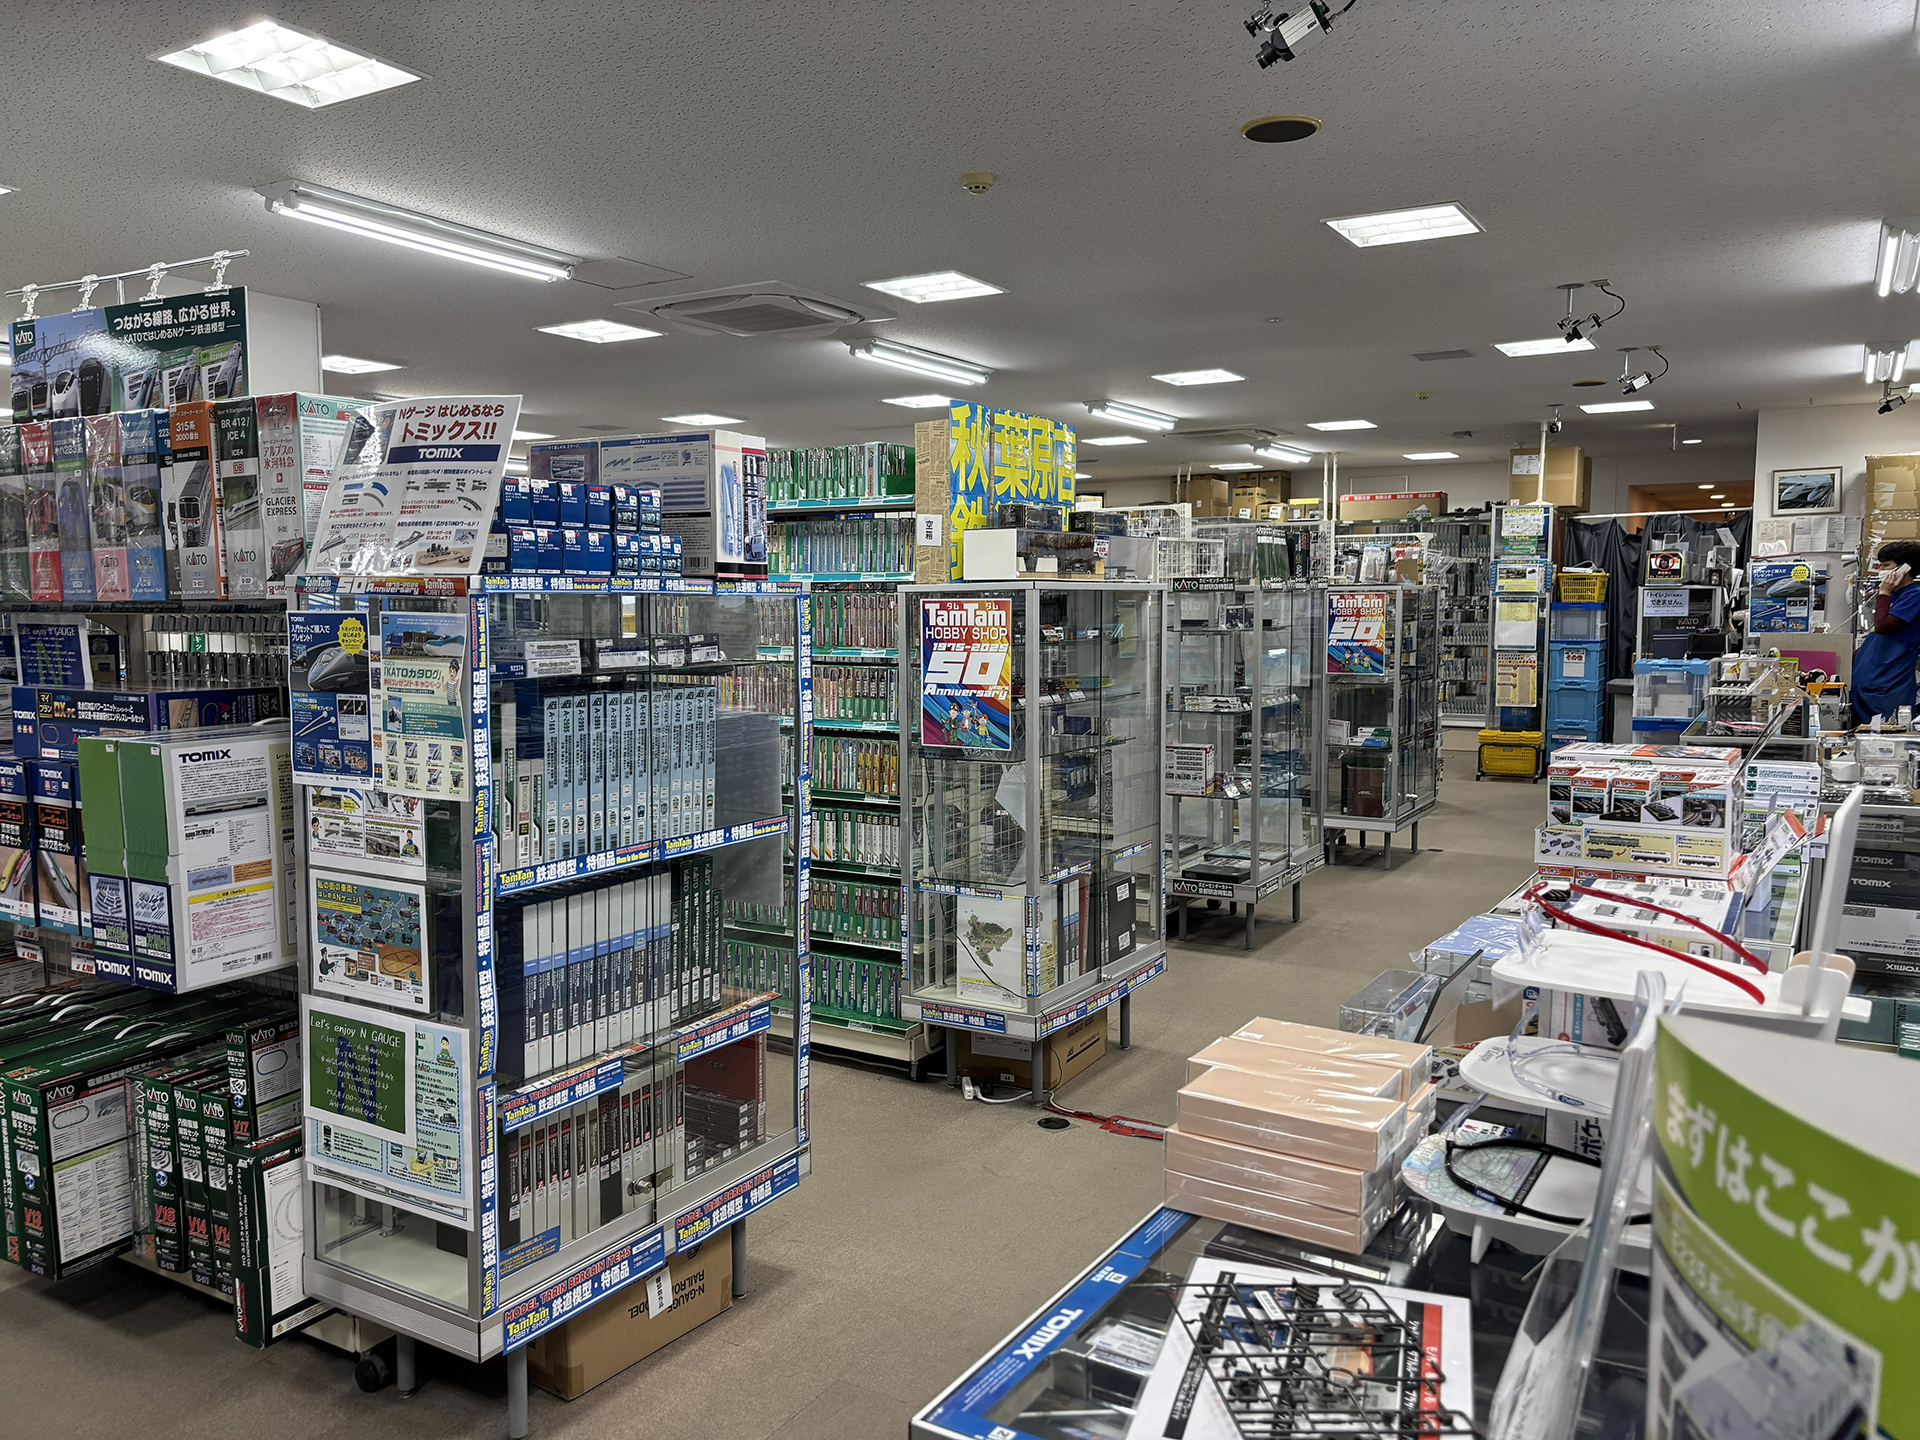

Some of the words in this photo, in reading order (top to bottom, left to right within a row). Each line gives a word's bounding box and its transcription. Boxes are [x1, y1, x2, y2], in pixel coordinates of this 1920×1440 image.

[114, 301, 236, 330] つながる線路、広がる世界。
[15, 330, 34, 345] KATO
[124, 322, 226, 343] KATOではじめるNゲージ鉄道模型
[300, 401, 330, 416] KATO
[399, 405, 435, 420] Nゲージ
[438, 405, 505, 418] はじめるなら
[176, 420, 196, 432] 315系
[221, 419, 231, 428] BR
[227, 432, 239, 441] ICE
[240, 432, 246, 440] 4
[402, 420, 498, 443] トミックス!!
[264, 446, 294, 457] アルプスの
[418, 447, 464, 459] TOMIX
[951, 404, 1077, 504] 秋葉原店
[264, 458, 295, 469] 氷河特急
[266, 496, 296, 507] GLACIER
[267, 506, 297, 516] EXPRESS
[925, 520, 934, 540] 空箱
[101, 556, 119, 568] KATO
[186, 552, 207, 566] KATO
[234, 548, 257, 563] KATO
[305, 578, 331, 589] TamTam
[423, 578, 454, 591] TamTam
[511, 577, 573, 590] 鉄道模型・特価品
[633, 580, 685, 591] 鉄道模型・特価品
[737, 583, 777, 593] 鉄道模型・特価品
[1175, 579, 1199, 590] KATO
[1330, 595, 1383, 608] TamTam
[925, 603, 1007, 627] TamTam
[1330, 608, 1358, 616] HOBBY
[1360, 608, 1384, 616] SHOP
[54, 627, 77, 636] GAUGE
[291, 625, 330, 634] 入門セットご購入で
[926, 628, 967, 640] HOBBY
[972, 627, 1008, 640] SHOP
[1329, 622, 1382, 640] 50
[933, 643, 1010, 652] 1975-2025
[1329, 639, 1384, 648] Anniversary
[384, 667, 442, 681] 「KATOカタログ」
[925, 652, 1008, 685] 50
[801, 635, 812, 723] 鉄道模型・特価品
[41, 694, 50, 703] マイ
[924, 684, 1010, 700] Anniversary
[13, 711, 36, 720] TOMIX
[39, 705, 53, 714] プラン
[473, 670, 489, 787] 鉄道模型・特価品
[179, 750, 232, 764] TOMIX
[0, 766, 18, 776] OMIX
[39, 769, 63, 779] TOMIX
[475, 791, 484, 835] TamTam
[665, 838, 692, 850] TamTam
[694, 823, 754, 850] 鉄道模型・特価品
[801, 815, 812, 900] 鉄道模型・特価品
[1854, 856, 1894, 866] TOMIX
[500, 870, 534, 885] TamTam
[536, 851, 616, 883] 鉄道模型・特価品
[500, 882, 519, 890] HOBBY
[520, 878, 535, 886] SHOP
[936, 884, 976, 896] 鉄道模型・特価品
[1174, 882, 1198, 892] KATO
[1851, 878, 1892, 888] TOMIX
[96, 959, 131, 977] TOMIX
[477, 912, 496, 1028] 鉄道模型・特価品
[137, 967, 173, 985] TOMIX
[944, 1012, 985, 1026] 鉄道模型・特価品
[226, 1032, 244, 1044] KATO
[251, 1028, 276, 1043] KATO
[310, 1016, 330, 1030] Let's
[334, 1025, 356, 1039] enjoy
[360, 1028, 367, 1039] N
[372, 1031, 401, 1048] GAUGE
[704, 1020, 749, 1049] 鉄道模型・特価品
[480, 1031, 491, 1074] TamTam
[800, 1002, 811, 1089] 鉄道模型・特価品
[47, 1085, 75, 1101] KATO
[147, 1087, 169, 1103] KATO
[504, 1096, 528, 1112] MODEL
[530, 1088, 550, 1102] TRAIN
[551, 1078, 578, 1094] BARGAIN
[580, 1067, 597, 1082] ITEMS
[12, 1089, 32, 1106] KATO
[135, 1081, 145, 1115] KATO
[176, 1094, 197, 1110] KATO
[506, 1105, 536, 1121] TamTam
[538, 1078, 596, 1114] 鉄道模型・特価品
[677, 1209, 703, 1229] MODEL
[703, 1195, 723, 1214] TRAIN
[724, 1180, 753, 1202] BARGAIN
[754, 1168, 773, 1187] ITEMS
[155, 1204, 175, 1223] V16
[480, 1154, 497, 1268] 鉄道模型・特価品
[678, 1218, 711, 1240] TamTam
[712, 1180, 772, 1228] 鉄道模型・特価品
[189, 1216, 207, 1234] V14
[678, 1234, 697, 1248] HOBBY
[697, 1225, 711, 1238] SHOP
[483, 1271, 492, 1314] TamTam
[505, 1298, 540, 1324] MODEL
[541, 1284, 566, 1305] TRAIN
[569, 1260, 605, 1289] BARGAIN
[605, 1246, 631, 1267] ITEMS
[507, 1308, 550, 1337] TamTam
[552, 1260, 630, 1319] 鉄道模型・特価品
[667, 1283, 705, 1314] N-GAUGE
[507, 1327, 531, 1345] HOBBY
[532, 1316, 550, 1334] SHOP
[1012, 1308, 1085, 1360] TOMIX
